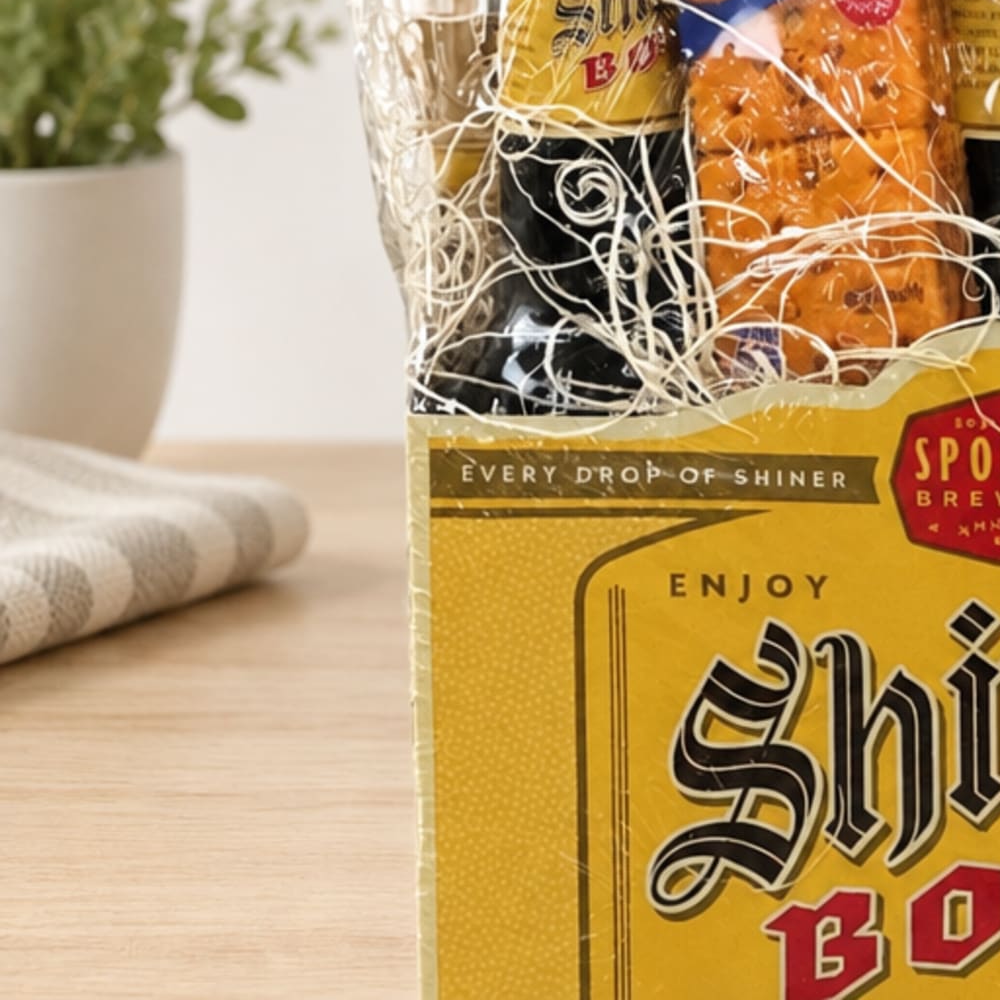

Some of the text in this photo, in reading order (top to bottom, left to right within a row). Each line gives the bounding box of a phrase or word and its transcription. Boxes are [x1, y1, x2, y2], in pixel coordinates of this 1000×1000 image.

[461, 464, 848, 489] EVERY DROP OF SHINER
[669, 572, 831, 604] ENJOY
